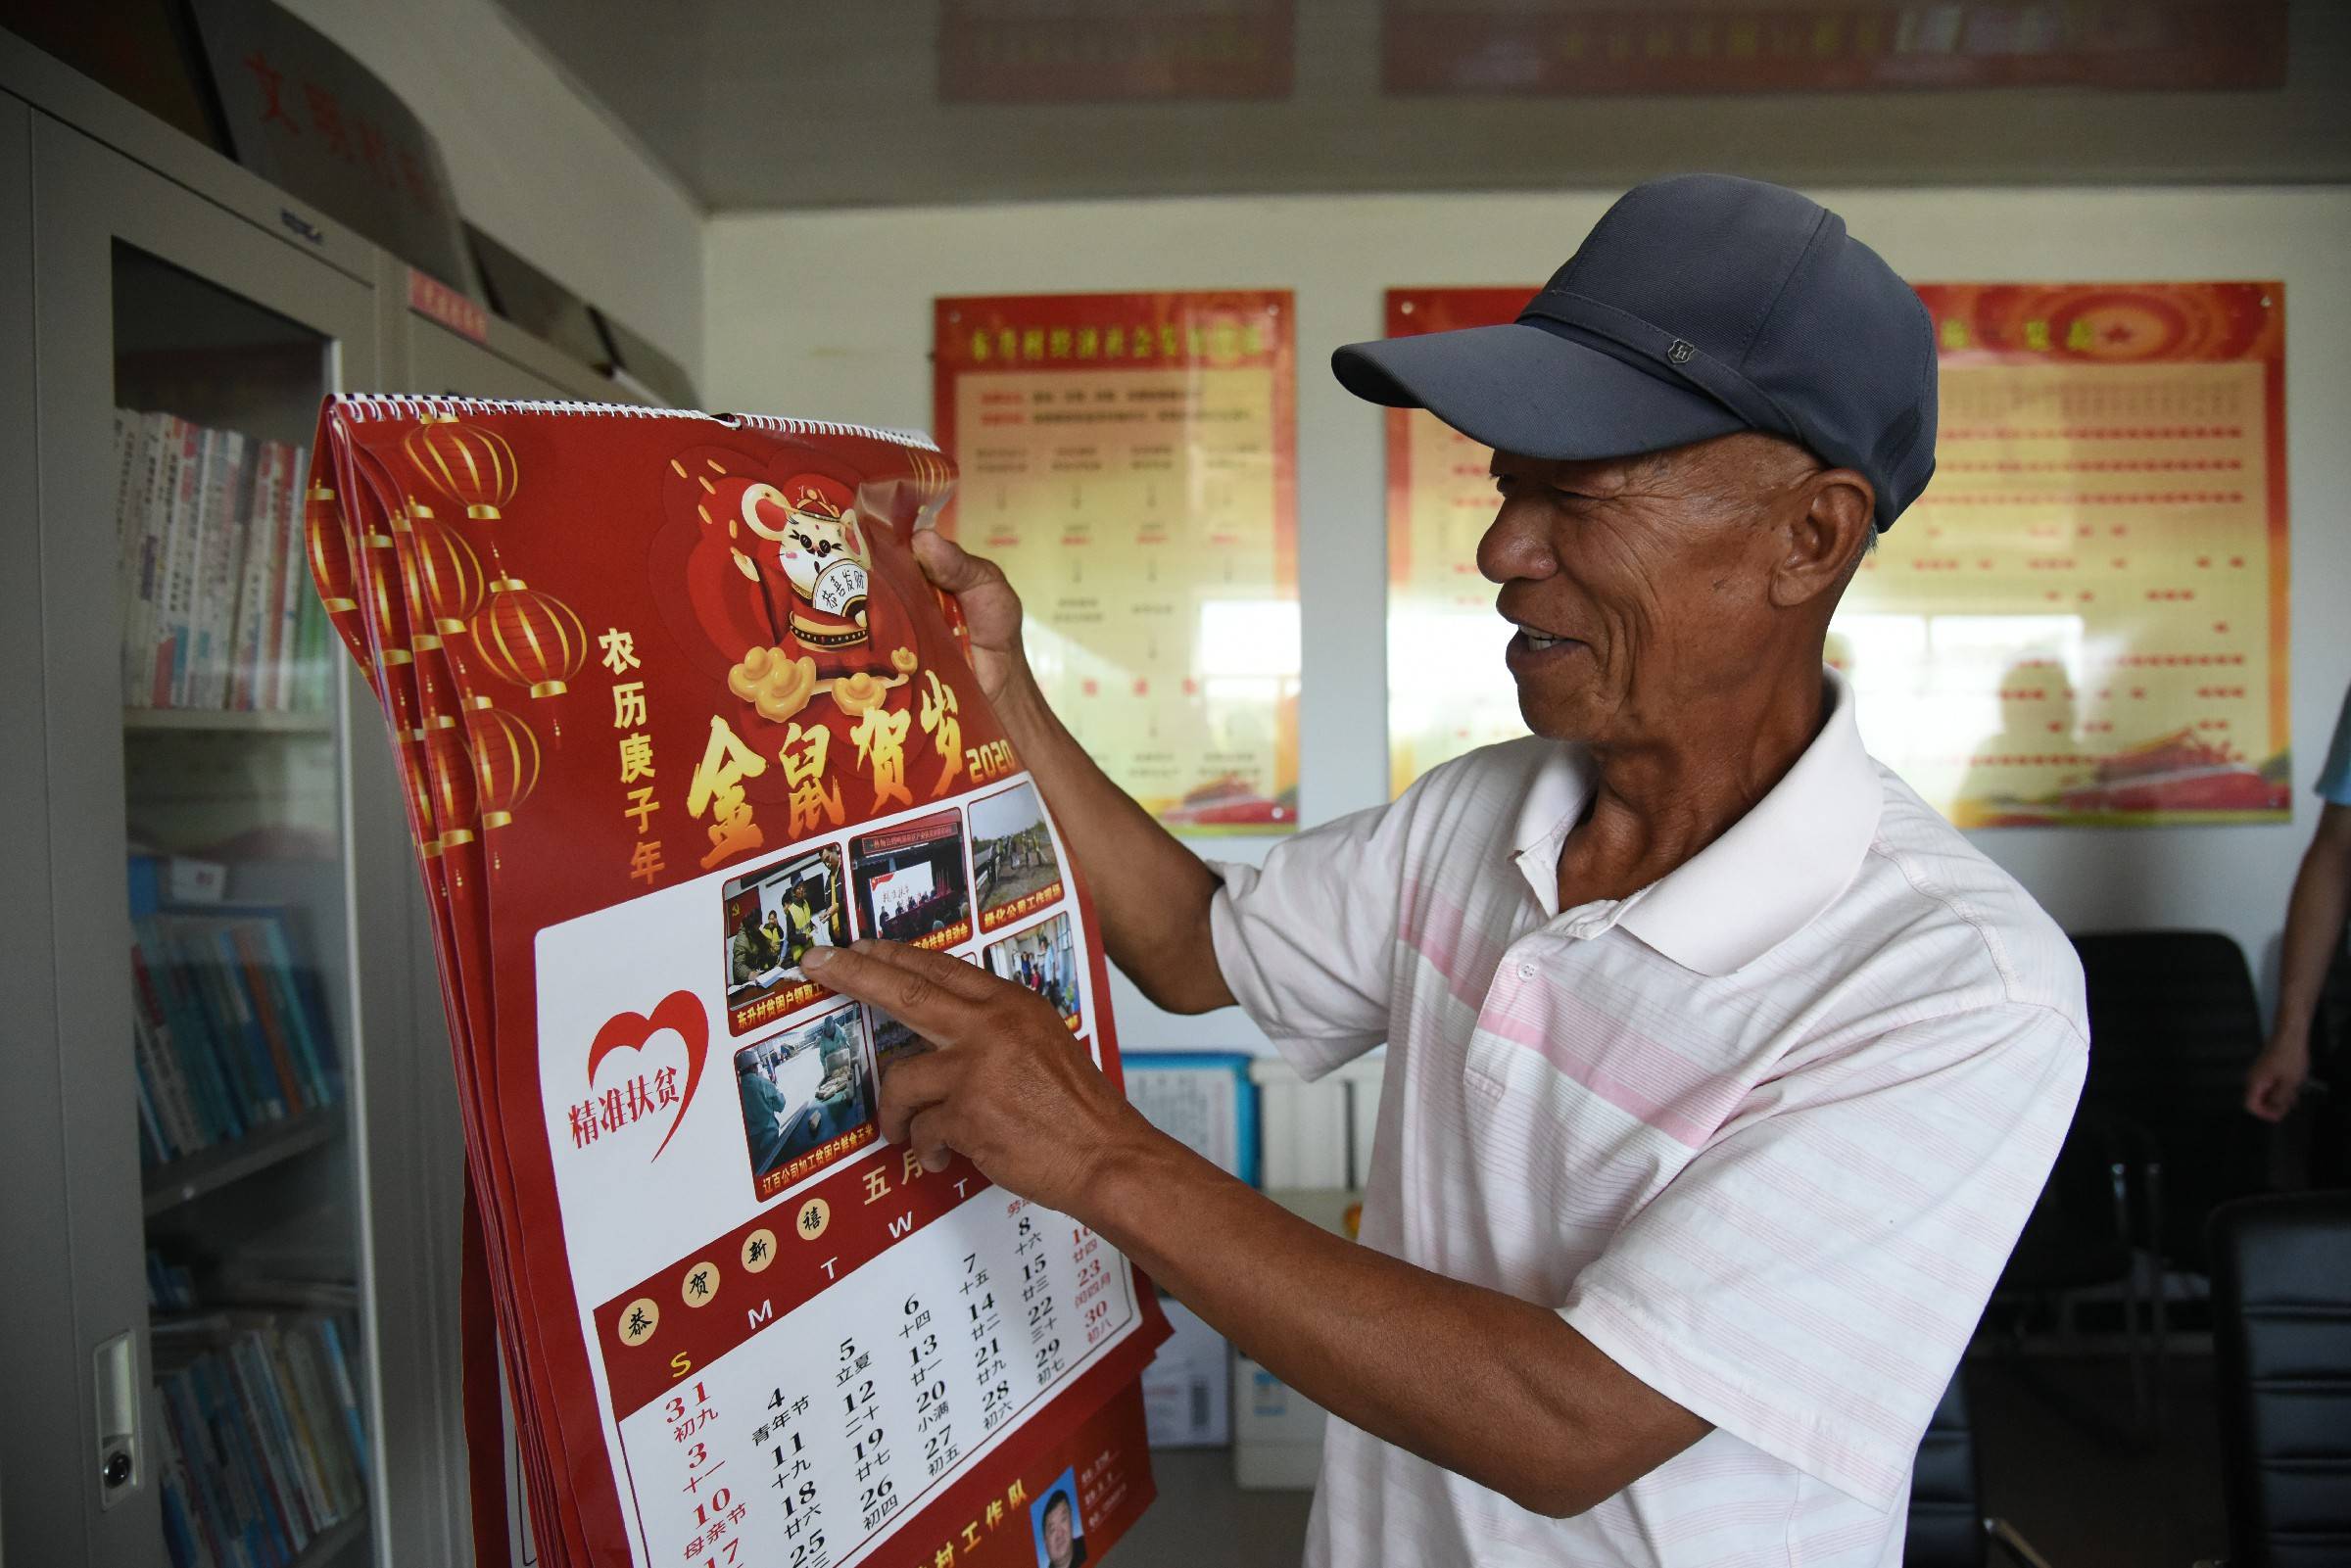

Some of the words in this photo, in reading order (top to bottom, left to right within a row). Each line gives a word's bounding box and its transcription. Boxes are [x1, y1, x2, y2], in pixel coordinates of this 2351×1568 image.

[599, 627, 667, 885] 农历庚子年
[687, 669, 964, 871] 金鼠贺岁
[965, 739, 1015, 784] 2020
[567, 1066, 680, 1150] 精准扶贫
[862, 1148, 924, 1207] 五月
[629, 1208, 822, 1338] 恭贺新禧
[670, 1352, 692, 1377] S
[747, 1299, 773, 1330] M
[821, 1257, 840, 1281] T
[888, 1212, 914, 1240] W
[953, 1178, 969, 1200] T
[683, 1460, 726, 1494] 十一
[752, 1396, 809, 1447] 青年节
[836, 1351, 872, 1388] 立夏
[898, 1310, 931, 1339] 十四
[959, 1268, 990, 1297] 十五
[1015, 1231, 1042, 1257] 十六
[688, 1443, 707, 1469] 3
[768, 1388, 785, 1410] 4
[840, 1337, 855, 1361] 5
[904, 1293, 919, 1315] 6
[963, 1254, 976, 1274] 7
[1019, 1216, 1031, 1236] 8
[665, 1382, 710, 1423] 31
[674, 1407, 718, 1443] 初九
[684, 1502, 746, 1560] 母亲节
[771, 1458, 811, 1490] 十九
[845, 1405, 880, 1438] 二十
[911, 1358, 942, 1387] 廿一
[971, 1313, 1001, 1342] 廿二
[1022, 1275, 1050, 1303] 廿三
[1073, 1238, 1098, 1264] 廿四
[694, 1488, 731, 1529] 10
[771, 1432, 806, 1469] 11
[843, 1380, 876, 1416] 12
[909, 1334, 937, 1367] 13
[969, 1293, 995, 1323] 14
[1022, 1253, 1046, 1283] 15
[704, 1538, 739, 1568] 17
[781, 1481, 816, 1520] 18
[853, 1428, 884, 1464] 19
[917, 1381, 945, 1414] 20
[975, 1338, 999, 1367] 21
[1028, 1296, 1054, 1326] 22
[1078, 1259, 1102, 1287] 23
[785, 1504, 822, 1540] 廿六
[855, 1449, 890, 1483] 廿七
[918, 1402, 949, 1434] 小满
[977, 1359, 1007, 1386] 廿九
[1031, 1316, 1057, 1345] 三十
[790, 1529, 825, 1568] 25
[860, 1473, 893, 1513] 26
[925, 1424, 951, 1460] 27
[982, 1381, 1010, 1412] 28
[1035, 1338, 1060, 1369] 29
[1084, 1300, 1108, 1328] 30
[863, 1494, 898, 1532] 初四
[929, 1443, 960, 1477] 初五
[983, 1401, 1014, 1431] 初六
[1036, 1357, 1066, 1386] 初七
[1086, 1317, 1113, 1345] 初八
[919, 1478, 1028, 1568] 村工作队
